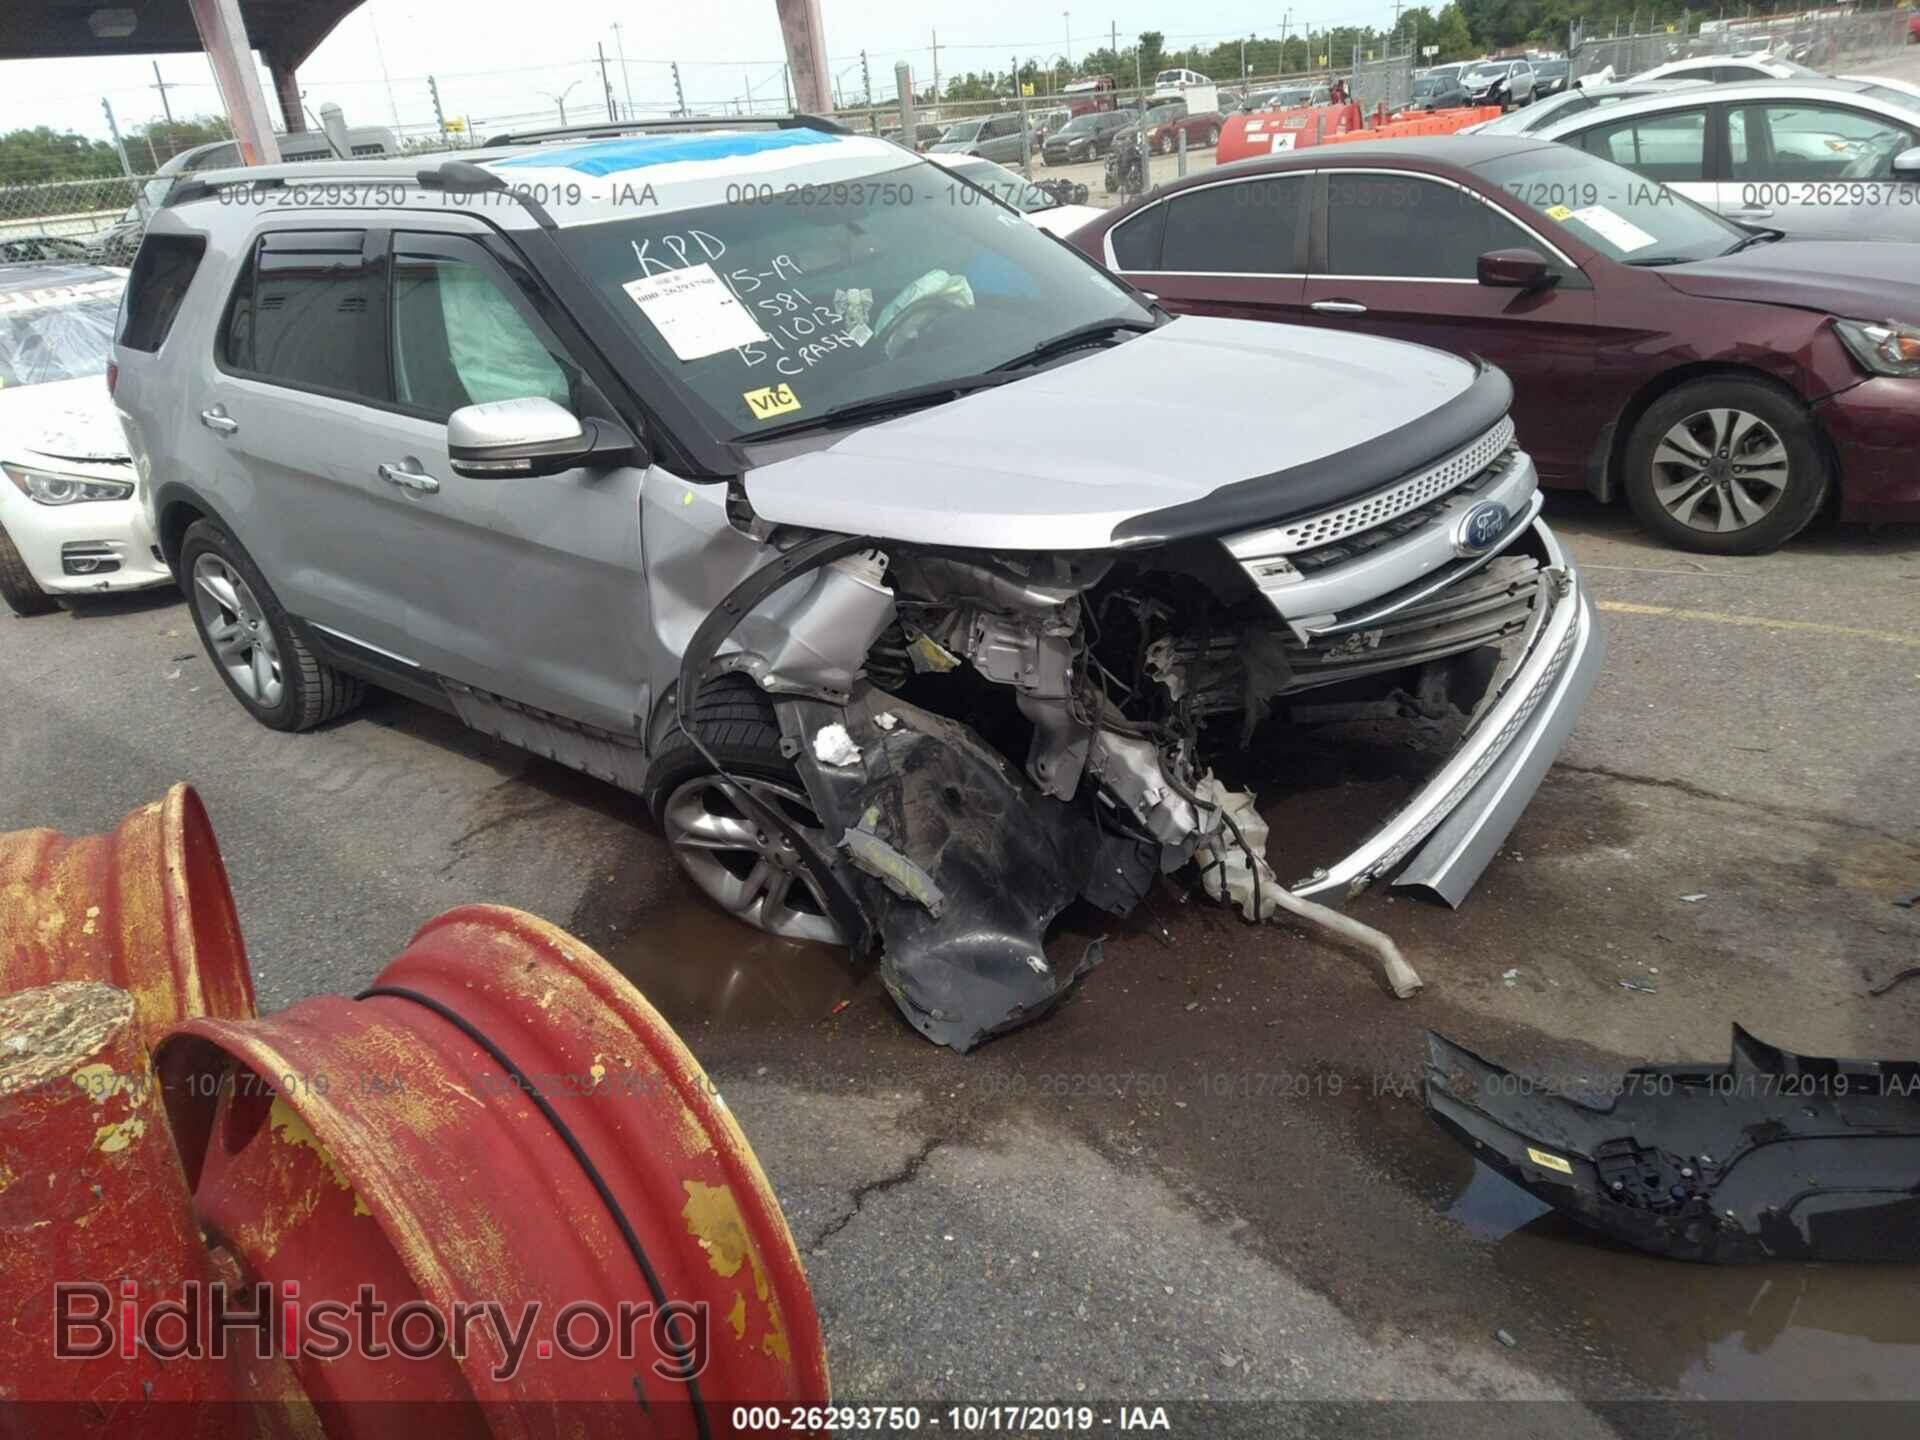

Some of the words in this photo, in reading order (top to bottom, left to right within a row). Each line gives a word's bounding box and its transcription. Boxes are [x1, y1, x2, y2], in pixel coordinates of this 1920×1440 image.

[631, 229, 727, 278] KPD
[751, 390, 793, 410] VIC
[1475, 508, 1505, 543] Ford
